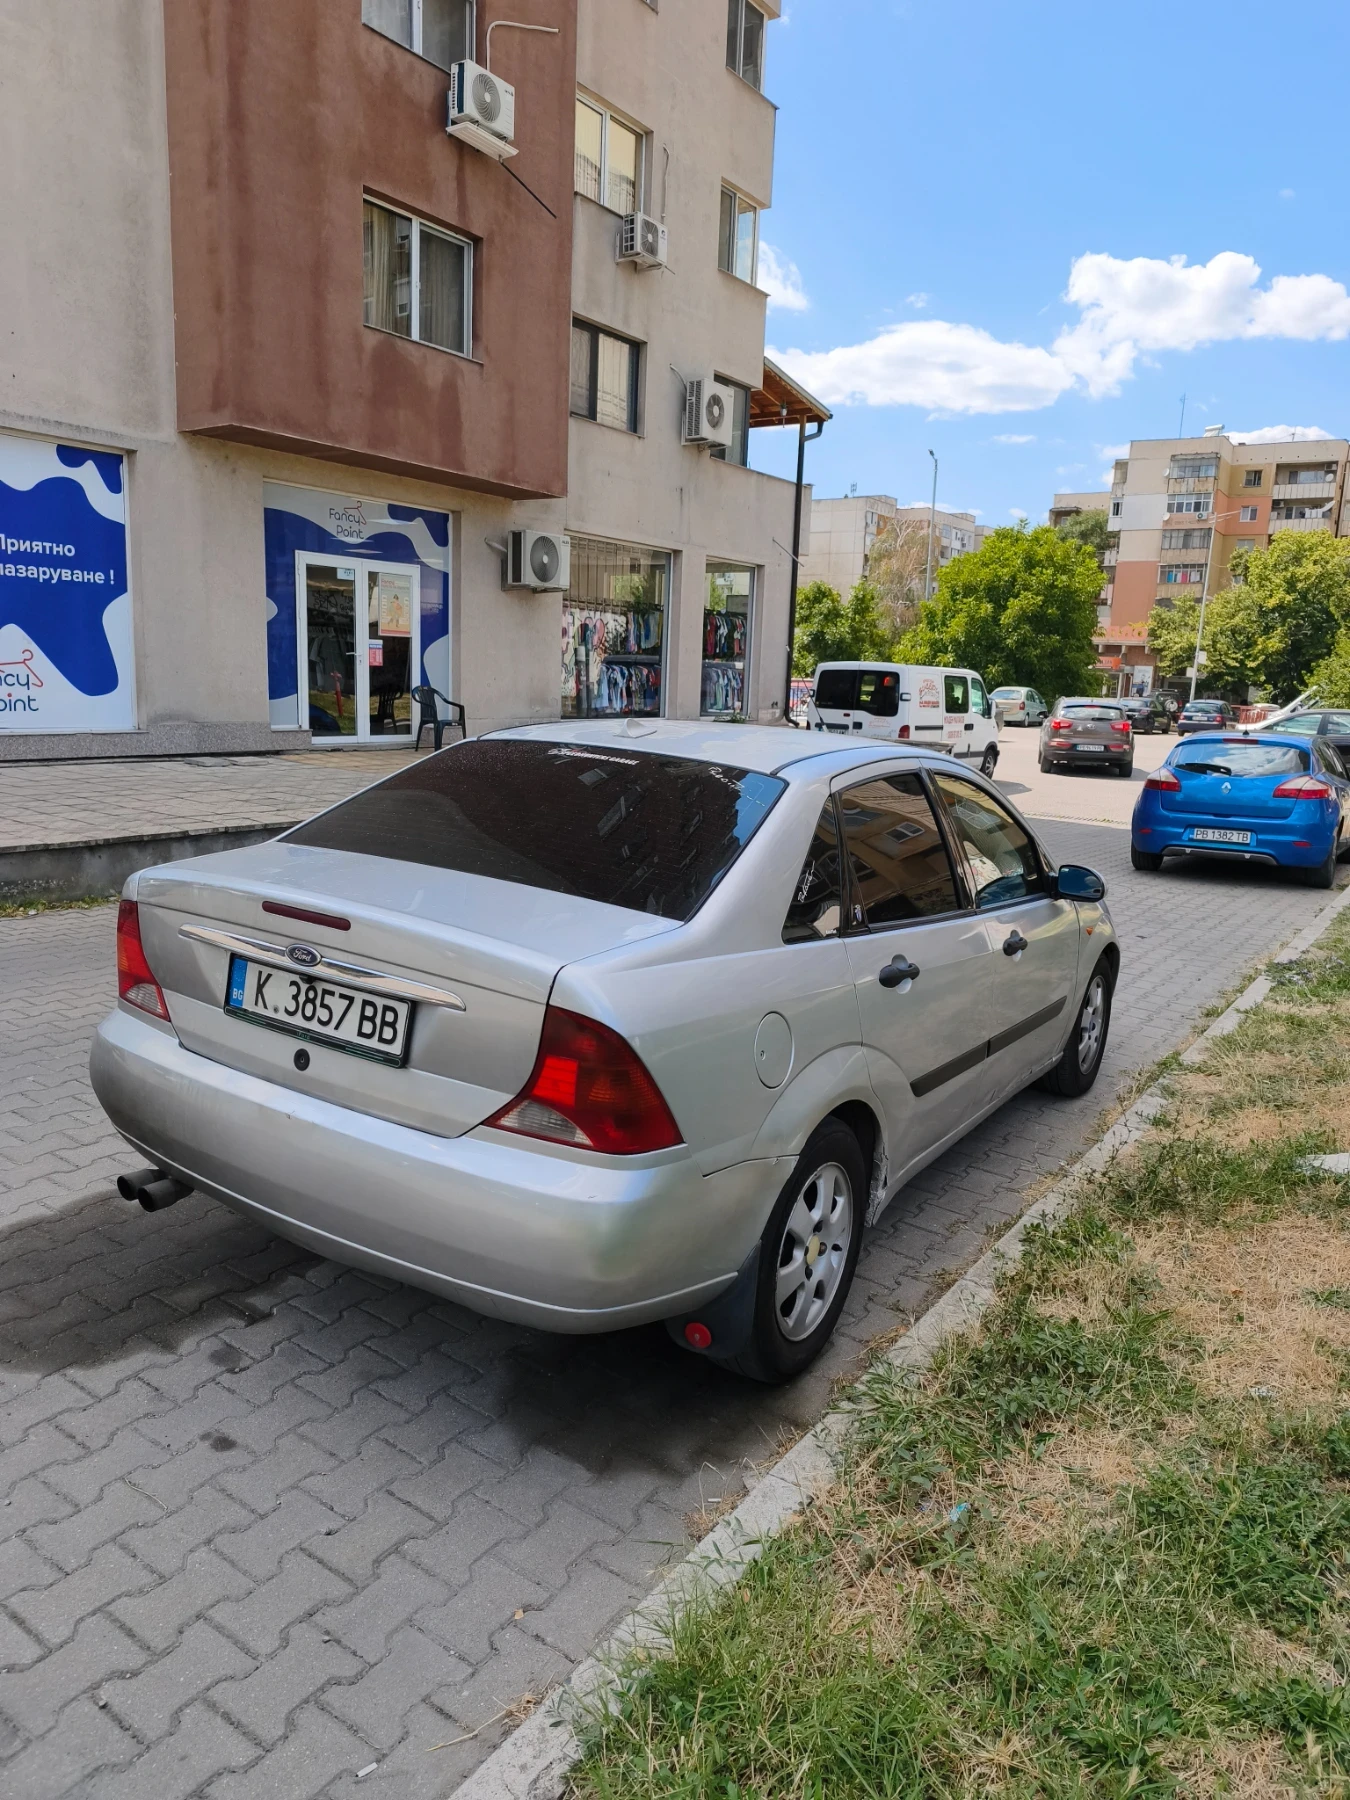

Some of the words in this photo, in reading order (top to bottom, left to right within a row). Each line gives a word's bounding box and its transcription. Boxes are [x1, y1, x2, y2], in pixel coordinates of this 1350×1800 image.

[329, 508, 361, 526] Fancy
[336, 525, 365, 540] Point
[0, 563, 105, 584] азаруване
[0, 673, 30, 690] cy
[1195, 829, 1208, 839] PB
[1211, 830, 1234, 841] 1382
[1236, 832, 1249, 842] TB
[293, 948, 312, 962] Ford
[232, 988, 244, 1001] BG
[254, 970, 273, 1010] K
[284, 980, 355, 1031] 3857
[357, 998, 399, 1045] BB
